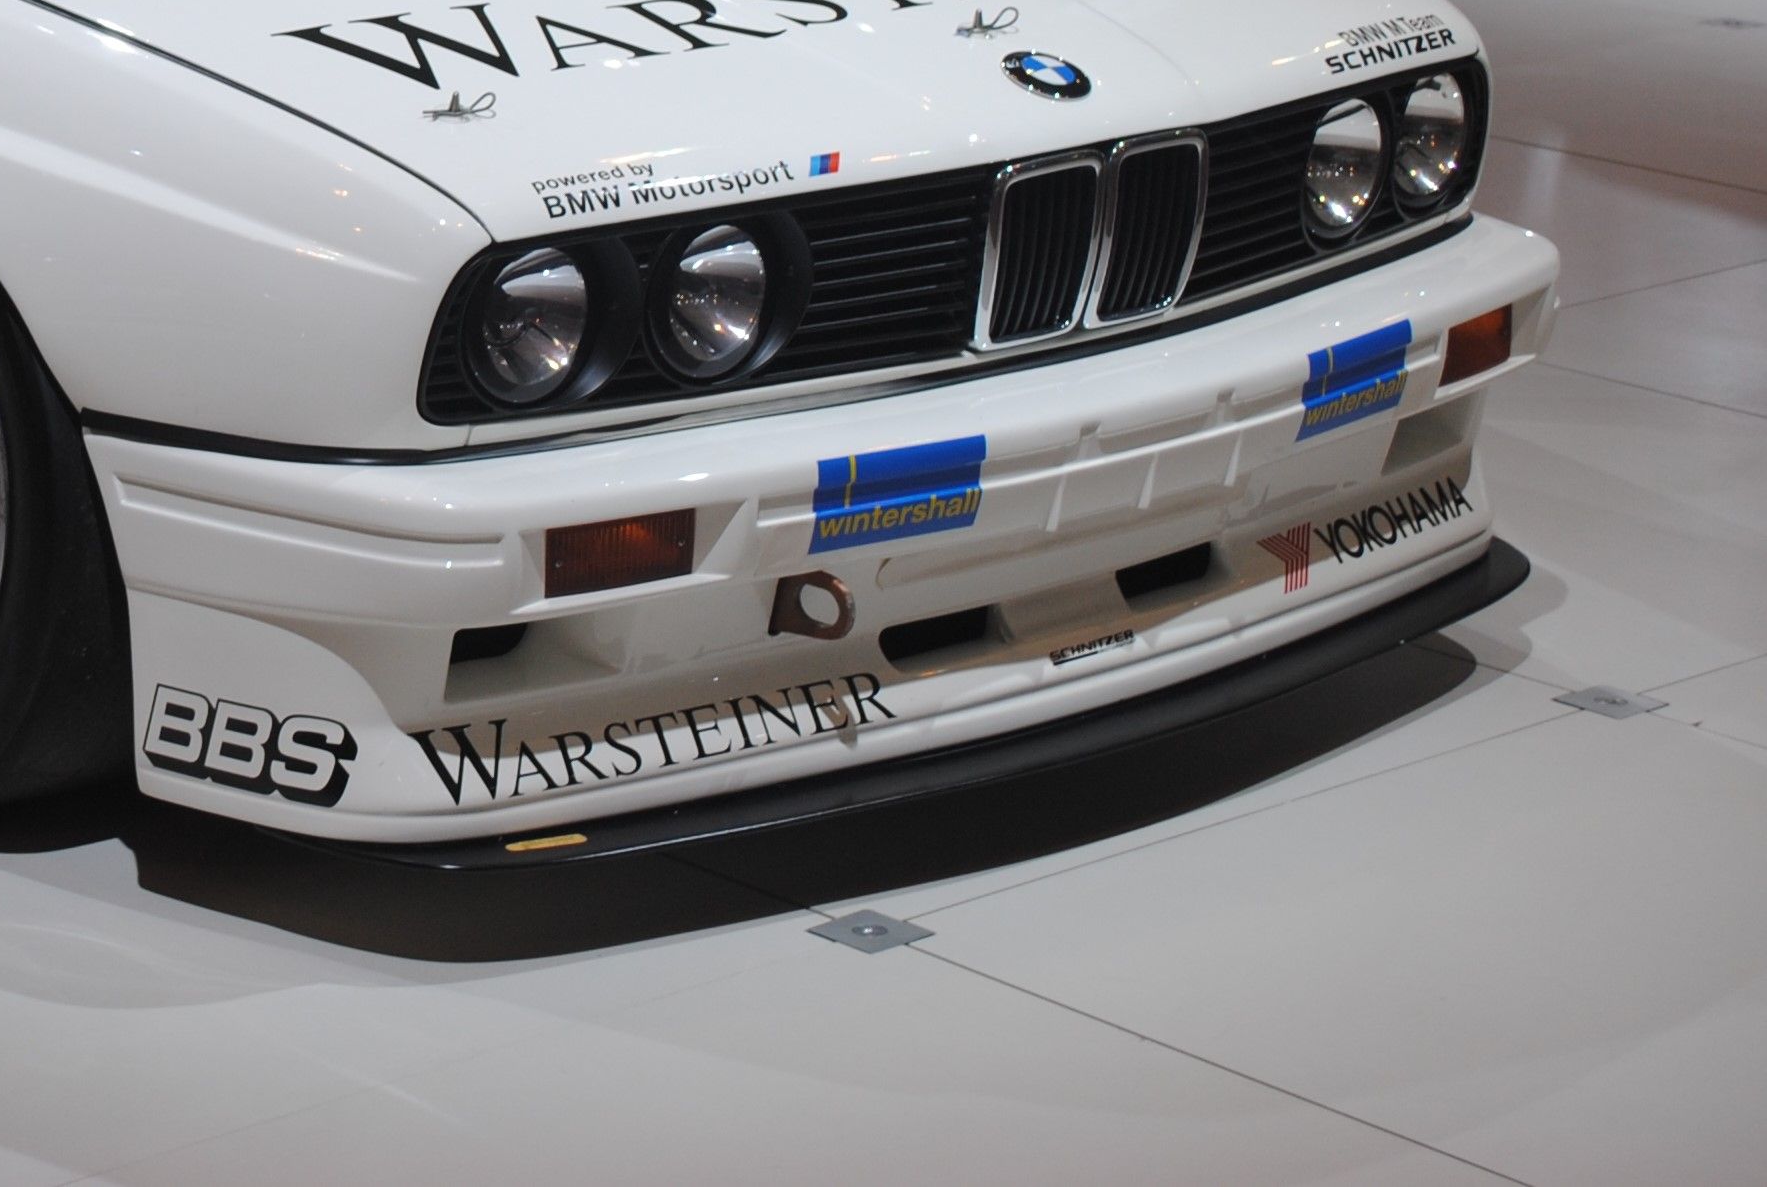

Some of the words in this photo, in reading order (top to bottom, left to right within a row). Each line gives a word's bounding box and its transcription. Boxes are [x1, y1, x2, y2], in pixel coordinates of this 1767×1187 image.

[1324, 28, 1457, 75] SCHNITZER
[531, 165, 625, 195] powered
[627, 161, 654, 180] by
[543, 185, 624, 220] BMW
[630, 159, 794, 206] Motorsport
[1305, 368, 1410, 429] wintershall
[818, 488, 983, 541] wintershall
[1315, 475, 1474, 566] YOKOHAMA
[1049, 628, 1134, 661] SCHNITZER
[142, 683, 360, 809] BBS
[406, 670, 900, 807] WARSTEINER
